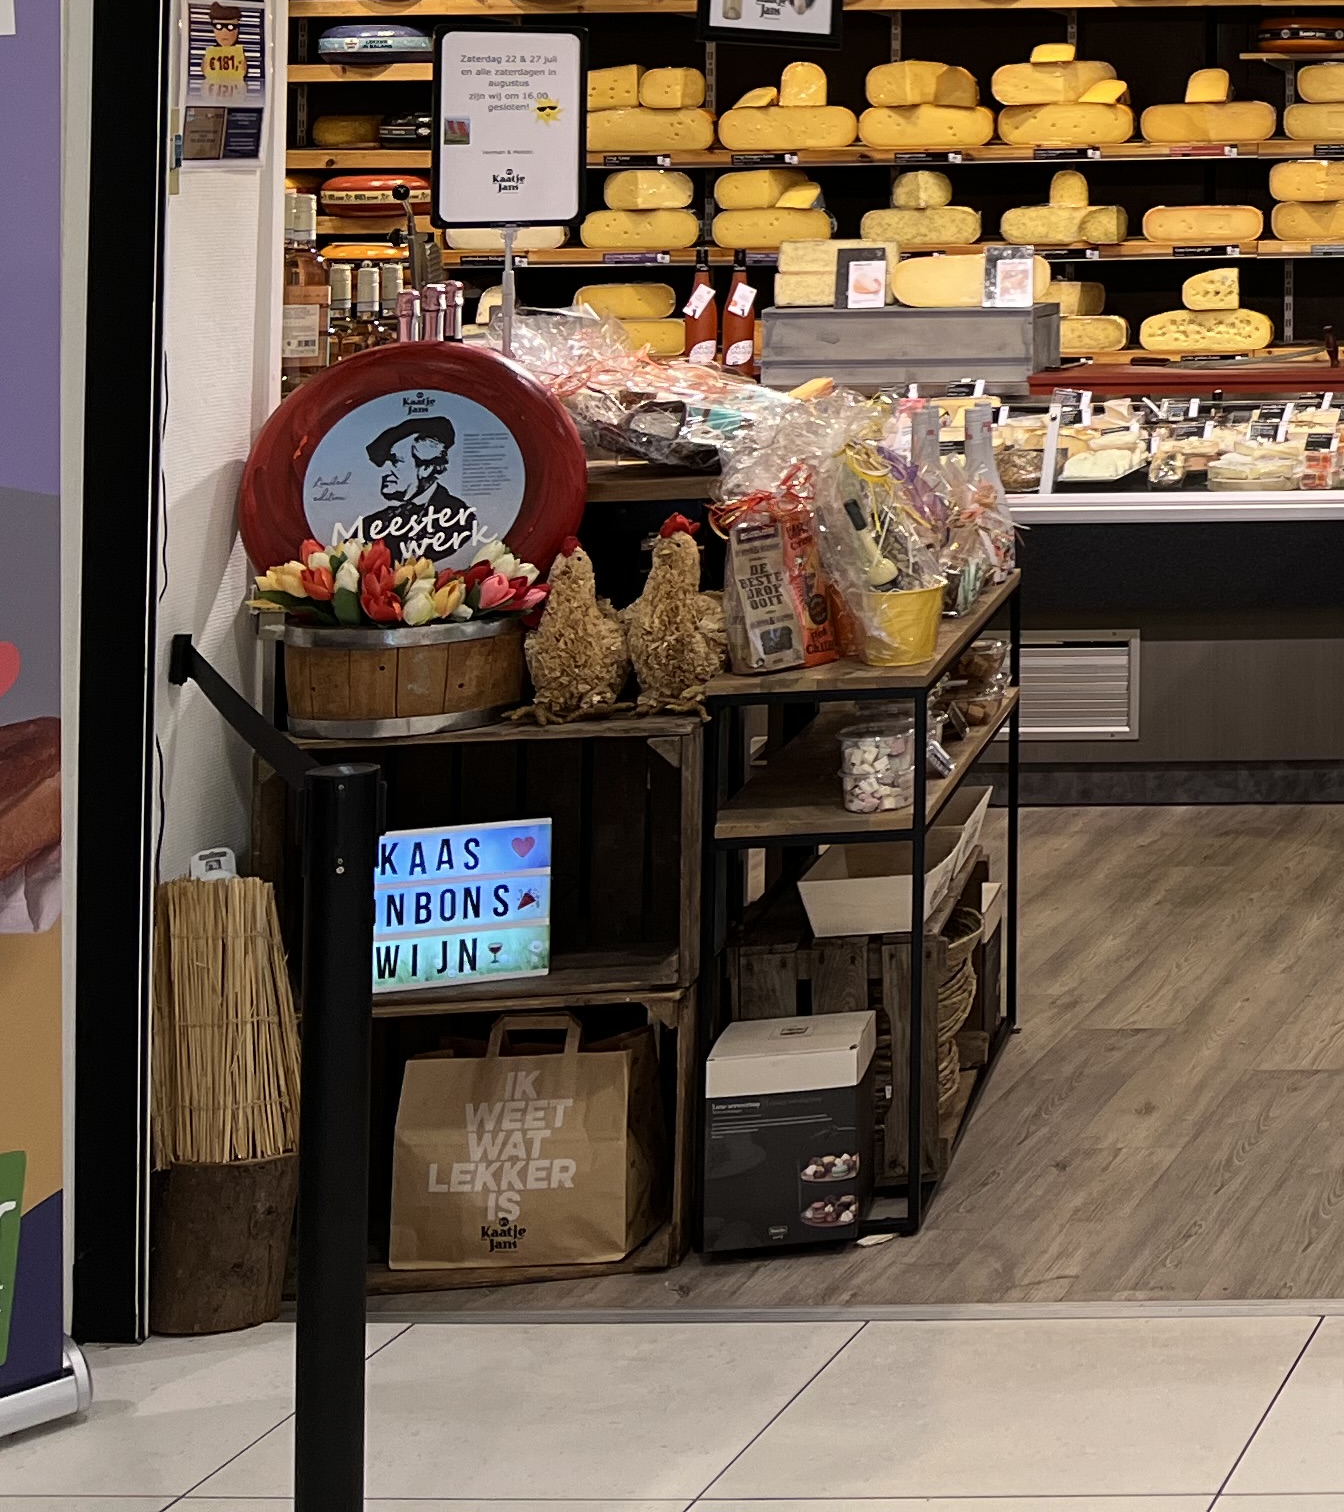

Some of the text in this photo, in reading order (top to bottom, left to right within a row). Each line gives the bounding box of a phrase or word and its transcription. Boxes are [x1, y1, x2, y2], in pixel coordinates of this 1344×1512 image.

[460, 55, 502, 64] Zaterdag
[505, 55, 517, 63] 22
[530, 55, 542, 63] 27
[543, 55, 558, 64] juli
[461, 68, 557, 77] en alle zaterdagen in
[469, 92, 486, 101] zijn
[488, 92, 502, 101] wij
[488, 80, 530, 88] augustus
[488, 103, 530, 112] gesloten!
[492, 174, 526, 185] Kaatje
[331, 505, 478, 546] Meester
[400, 520, 498, 560] werk
[738, 571, 784, 590] BESTE
[380, 837, 481, 876] KAAS
[374, 884, 510, 928] NBONS
[375, 938, 478, 979] WIJN
[505, 1070, 541, 1100] IK
[465, 1098, 573, 1131] WEET
[468, 1129, 551, 1162] WAT
[428, 1158, 577, 1192] LEKKER
[487, 1191, 521, 1221] IS
[481, 1224, 527, 1239] Kaatje
[489, 1238, 518, 1252] Jans
